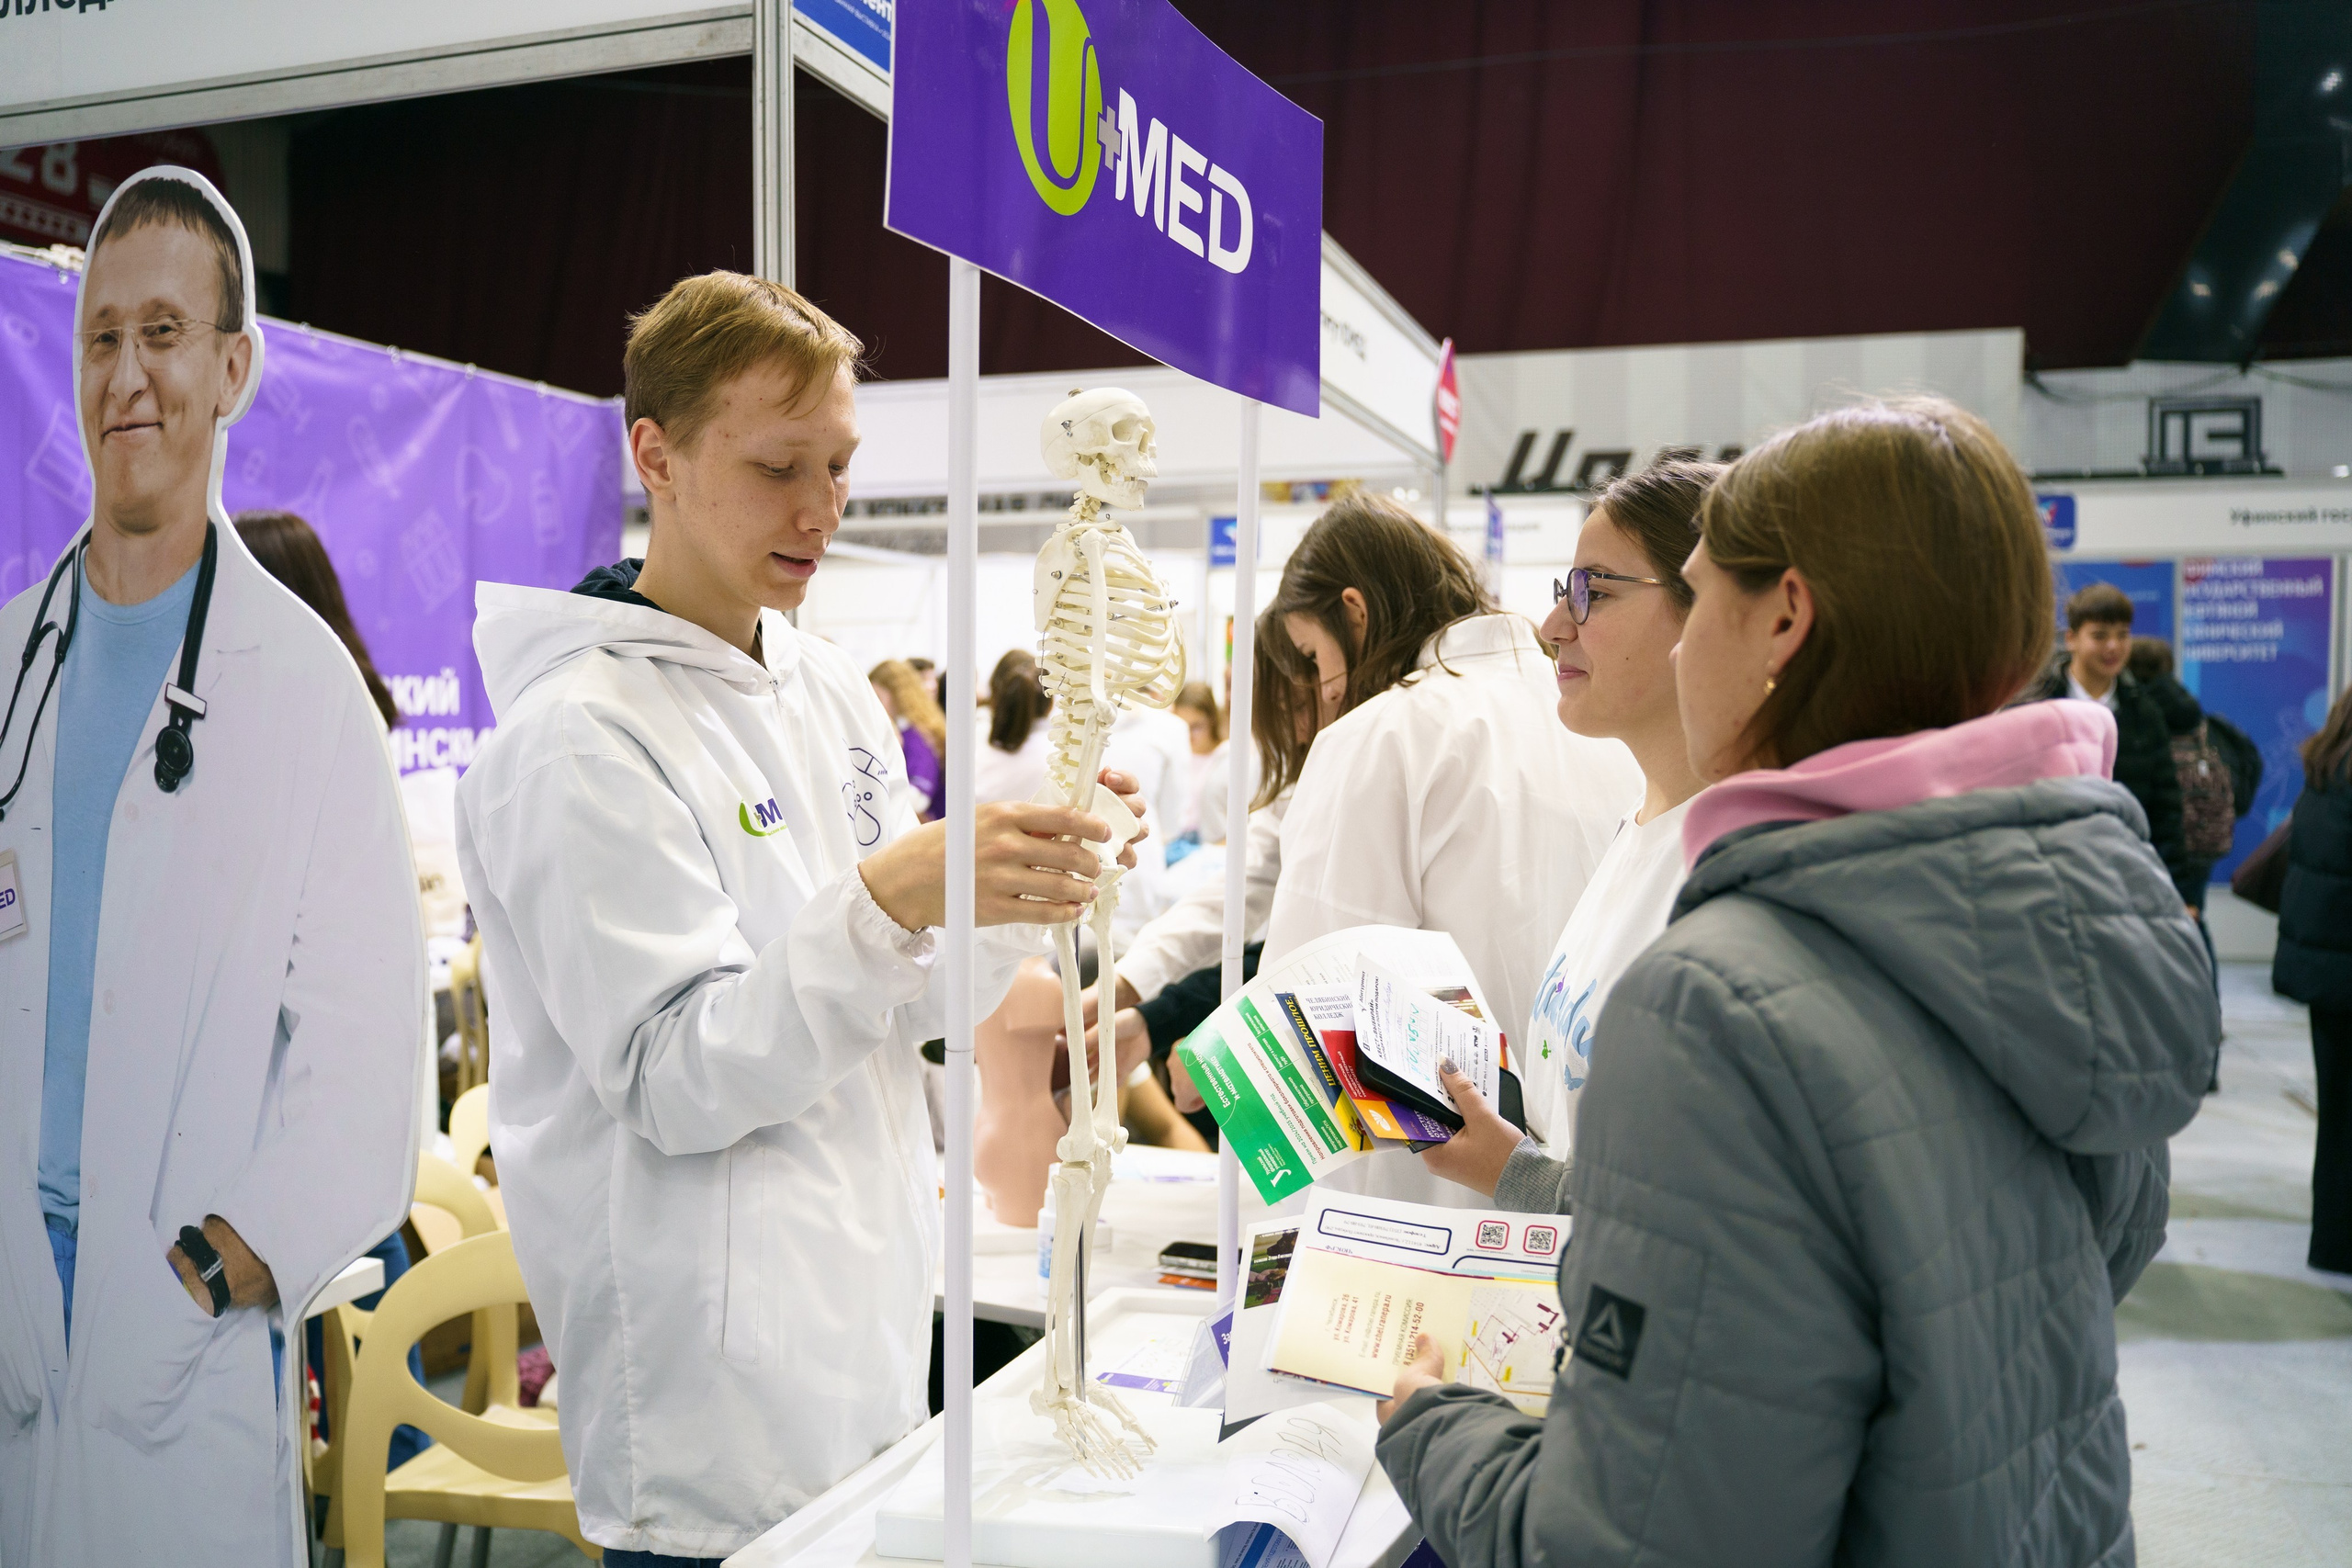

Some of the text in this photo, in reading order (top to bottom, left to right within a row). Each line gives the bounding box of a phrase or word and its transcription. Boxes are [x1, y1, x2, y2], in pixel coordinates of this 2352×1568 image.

[383, 666, 460, 717] КИЙ
[1306, 993, 1352, 1005] ЧЕЛЯБИНСКИЙ
[1283, 995, 1317, 1049] ПРОШЛОЕ,
[1313, 1010, 1345, 1021] КОЛЛЕДЖ
[1247, 1041, 1267, 1071] специалитета
[1374, 1038, 1383, 1058] КВЕСТ
[1209, 1055, 1237, 1095] математика
[1311, 1047, 1336, 1088] ЦЕНИМ
[1336, 1050, 1363, 1098] ГОСУДАРСТВЕННЫЙ
[1199, 1062, 1230, 1108] Естественные
[1266, 1072, 1289, 1105] бакалавриата
[1269, 1092, 1277, 1101] год
[1273, 1100, 1290, 1121] учебный
[1286, 1102, 1306, 1129] подготовки
[1413, 1107, 1434, 1139] ИНСТИТ
[1423, 1113, 1440, 1139] ОТРАС
[1285, 1119, 1303, 1143] 2024/2025
[1302, 1127, 1325, 1160] Направления
[1334, 1303, 1348, 1331] Комарова,
[1344, 1305, 1358, 1334] Комарова,
[1372, 1294, 1392, 1359] www.chel.ranepa.ru
[1408, 1302, 1424, 1339] 214-52-00
[1392, 1332, 1406, 1366] ПРИЕМНАЯ
